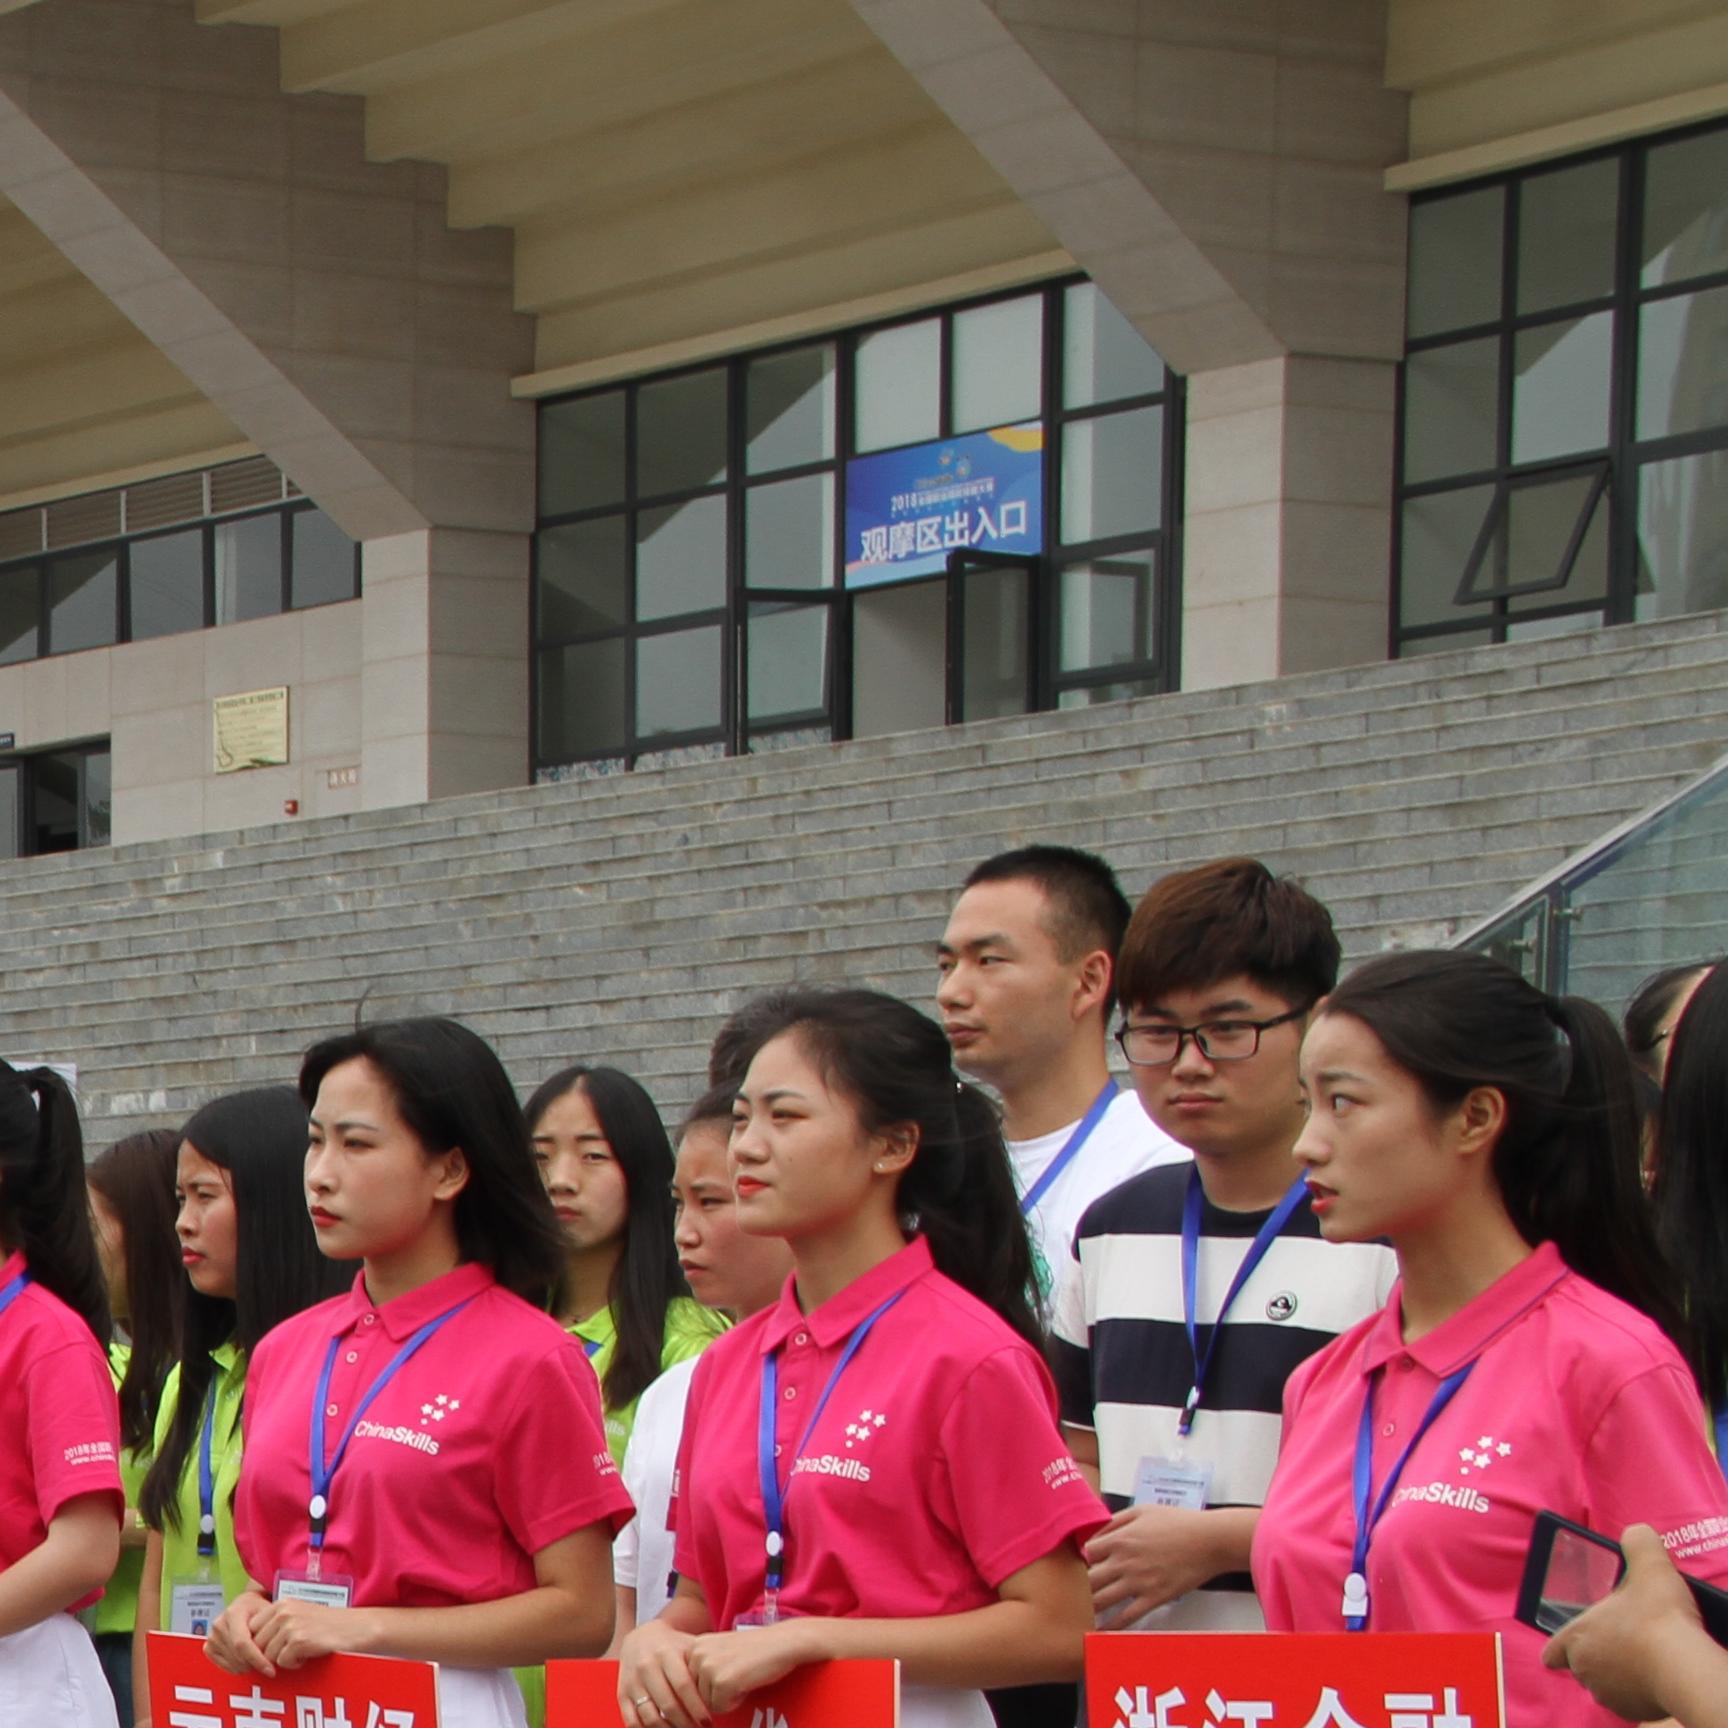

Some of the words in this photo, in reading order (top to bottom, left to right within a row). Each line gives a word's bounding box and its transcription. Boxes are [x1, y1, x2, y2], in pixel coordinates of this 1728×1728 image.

[860, 500, 1028, 563] 观摩区出入口
[354, 1420, 439, 1455] ChinaSkills
